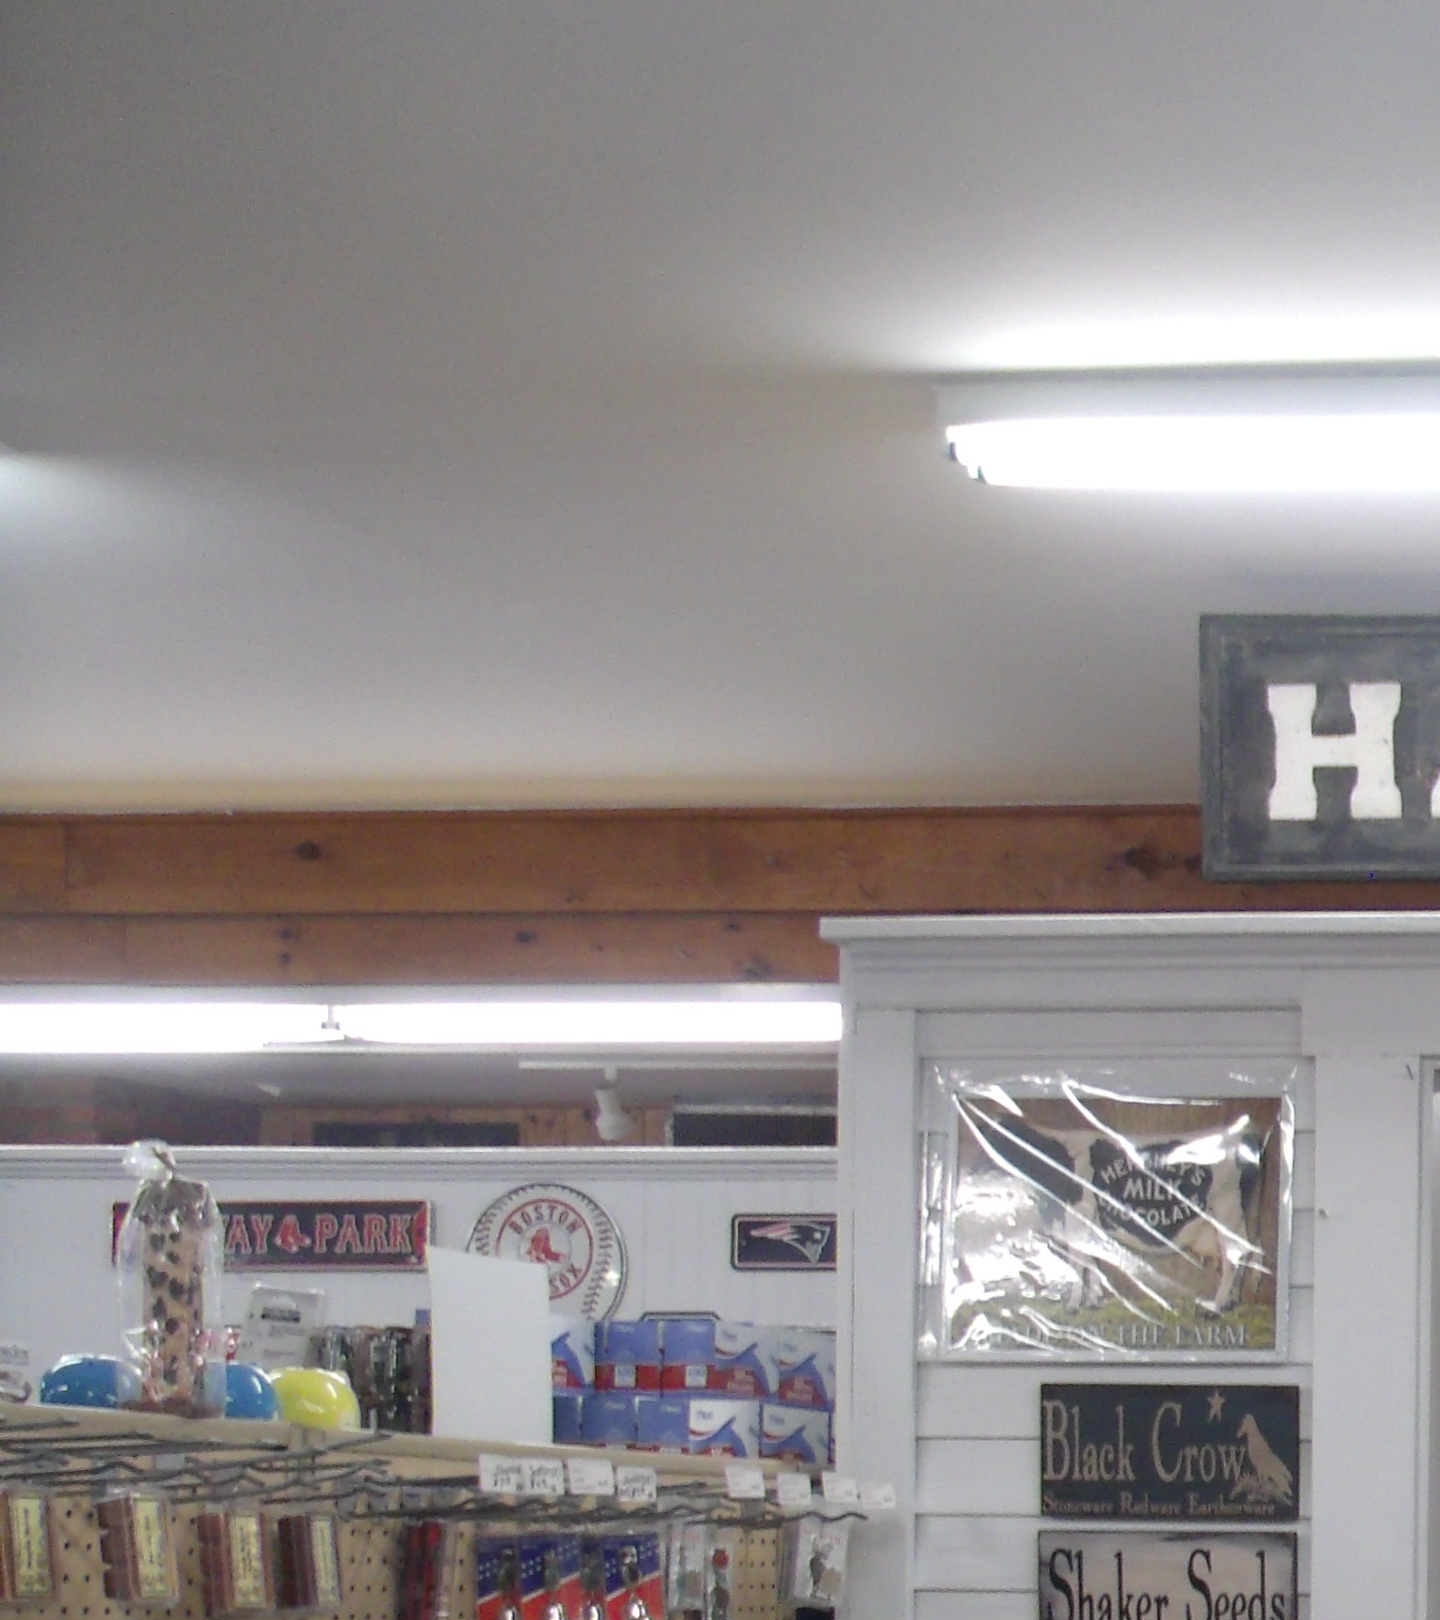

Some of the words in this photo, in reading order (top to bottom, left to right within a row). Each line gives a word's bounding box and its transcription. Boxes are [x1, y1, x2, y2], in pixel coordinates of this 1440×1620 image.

[1123, 1179, 1184, 1200] MILK
[316, 1214, 413, 1253] PARK
[509, 1203, 583, 1237] BOSTON
[1176, 1325, 1246, 1346] FARM
[1042, 1400, 1136, 1481] Black
[1152, 1402, 1248, 1483] Crow
